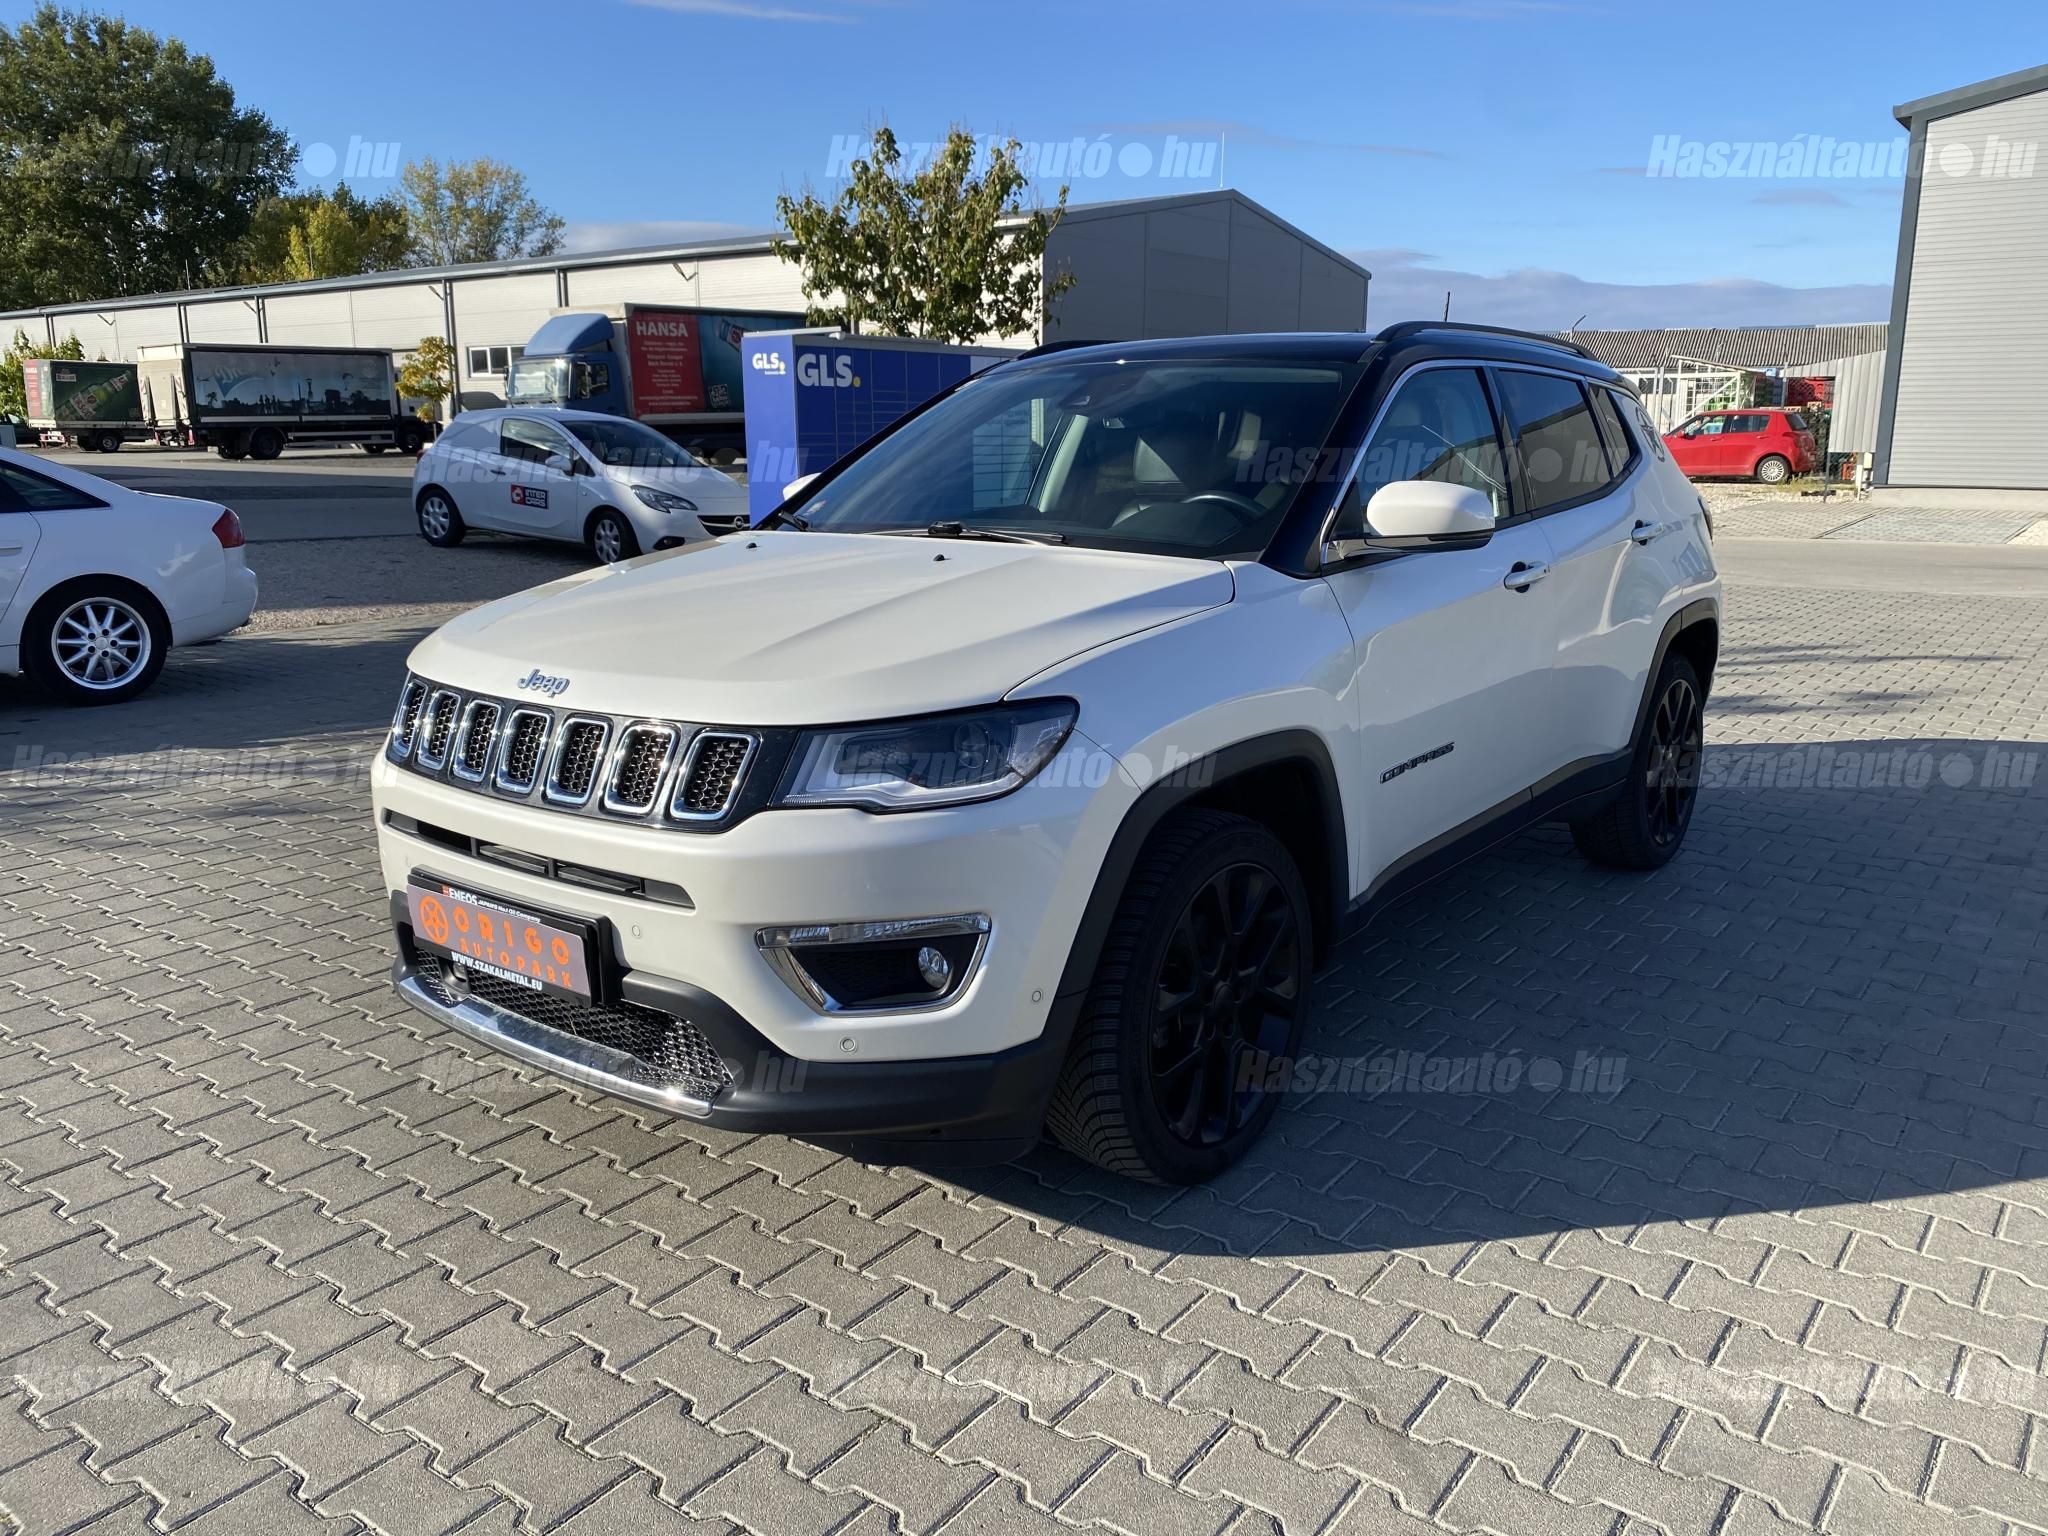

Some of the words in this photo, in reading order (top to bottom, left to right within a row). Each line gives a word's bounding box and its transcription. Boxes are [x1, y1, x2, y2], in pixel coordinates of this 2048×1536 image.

[636, 321, 688, 337] HANSA
[525, 489, 546, 499] INTER
[525, 498, 546, 507] CARS
[518, 669, 570, 698] Jeep
[448, 887, 478, 906] ENEOS
[453, 906, 569, 965] ORIGO
[451, 951, 543, 991] WWW.SZAKALMETAL.EU
[459, 938, 572, 988] AUTOPARK
